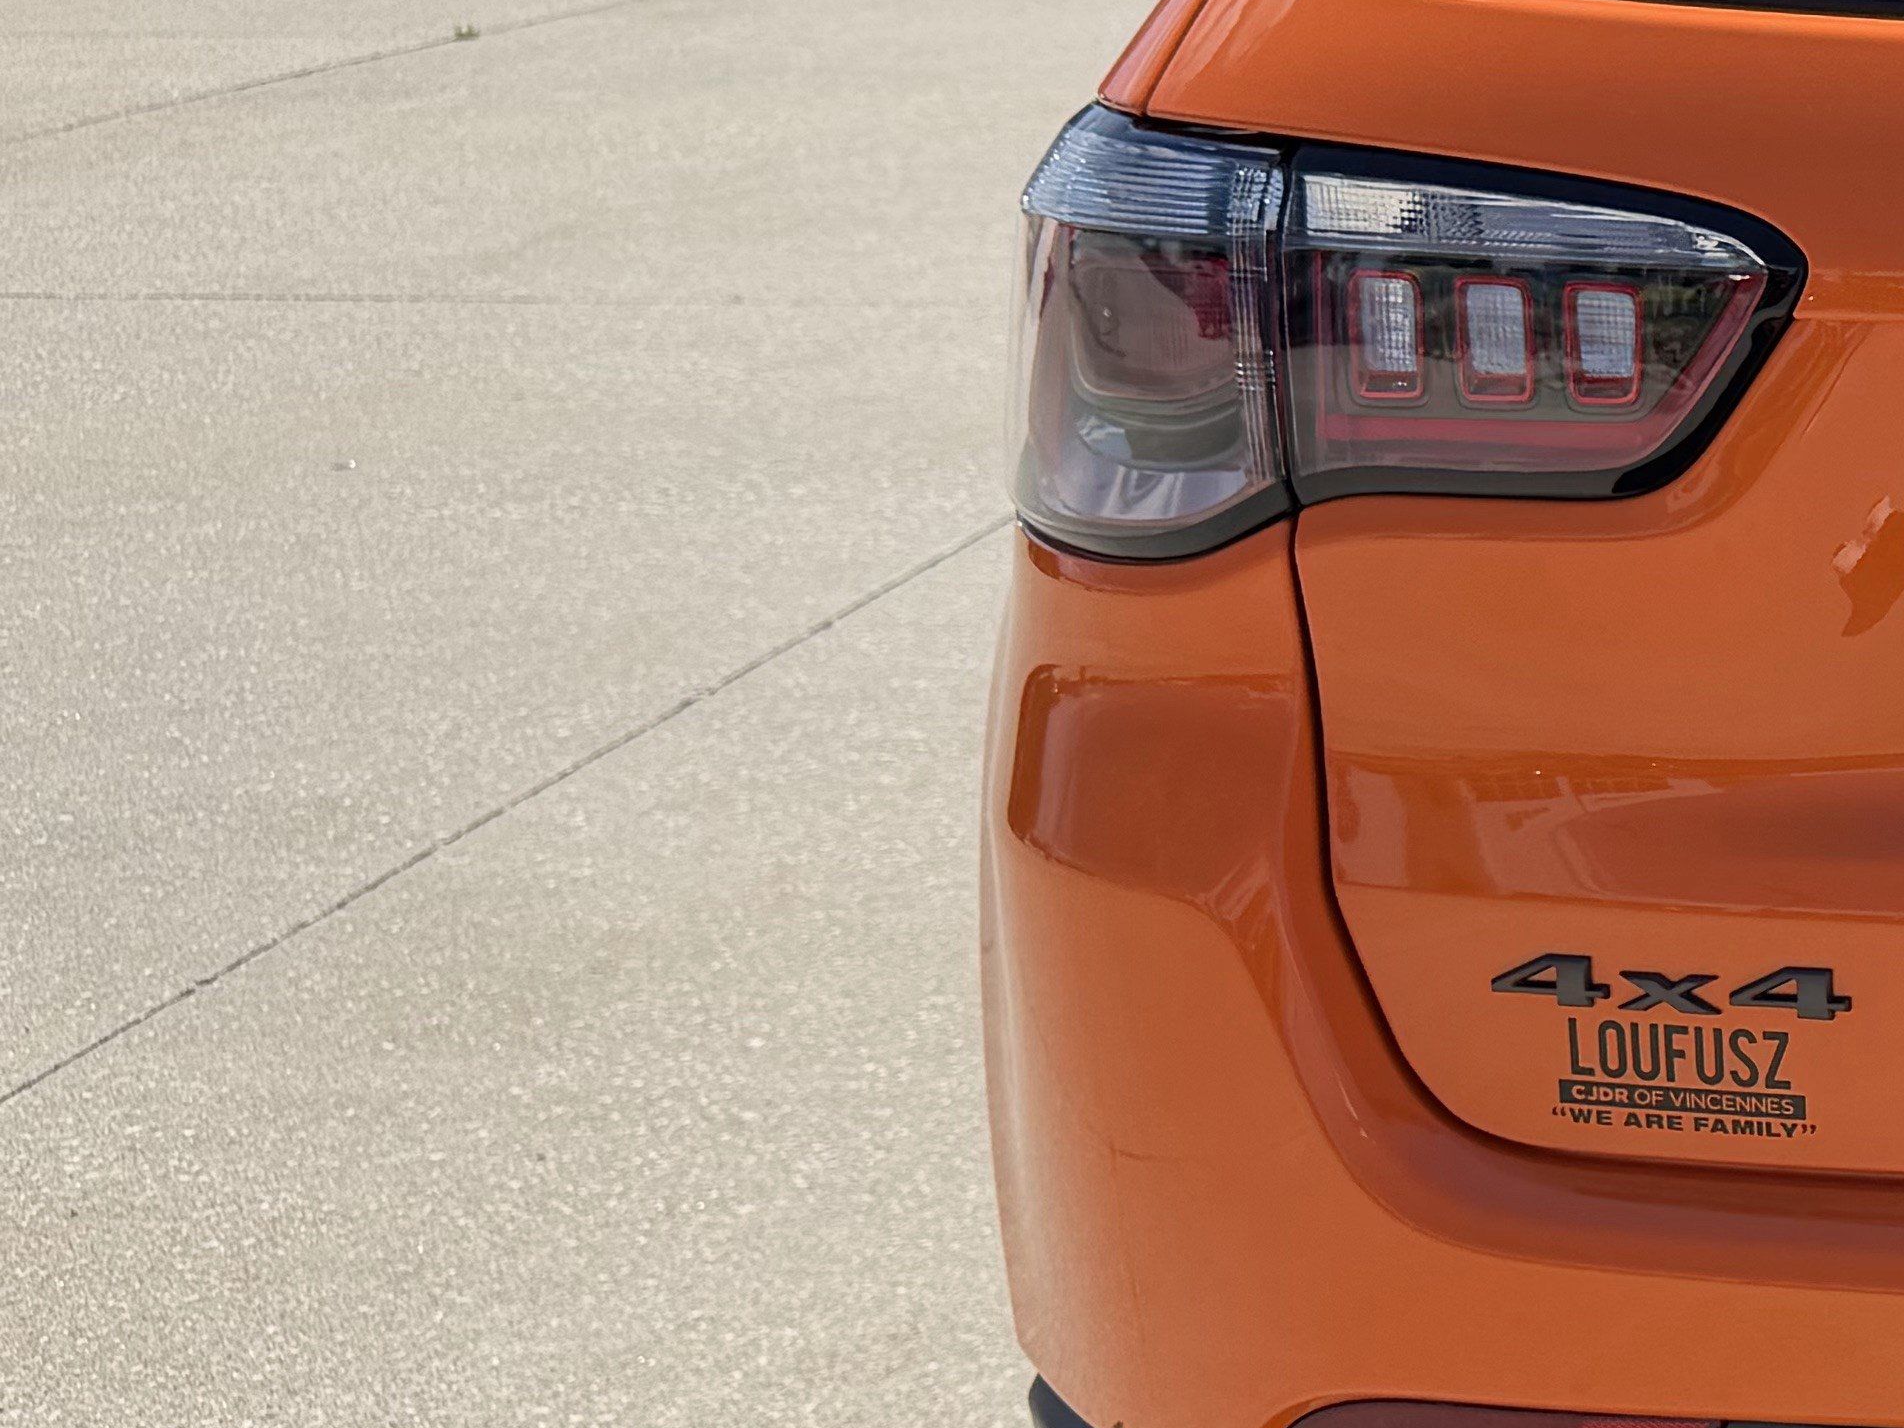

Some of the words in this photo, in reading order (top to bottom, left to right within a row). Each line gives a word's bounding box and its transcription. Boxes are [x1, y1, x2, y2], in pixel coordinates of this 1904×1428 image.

[1490, 953, 1853, 1021] 4x4
[1571, 1084, 1629, 1104] CJDR
[1633, 1088, 1664, 1107] OF
[1667, 1091, 1795, 1116] VINCENNES
[1623, 1110, 1685, 1132] ARE
